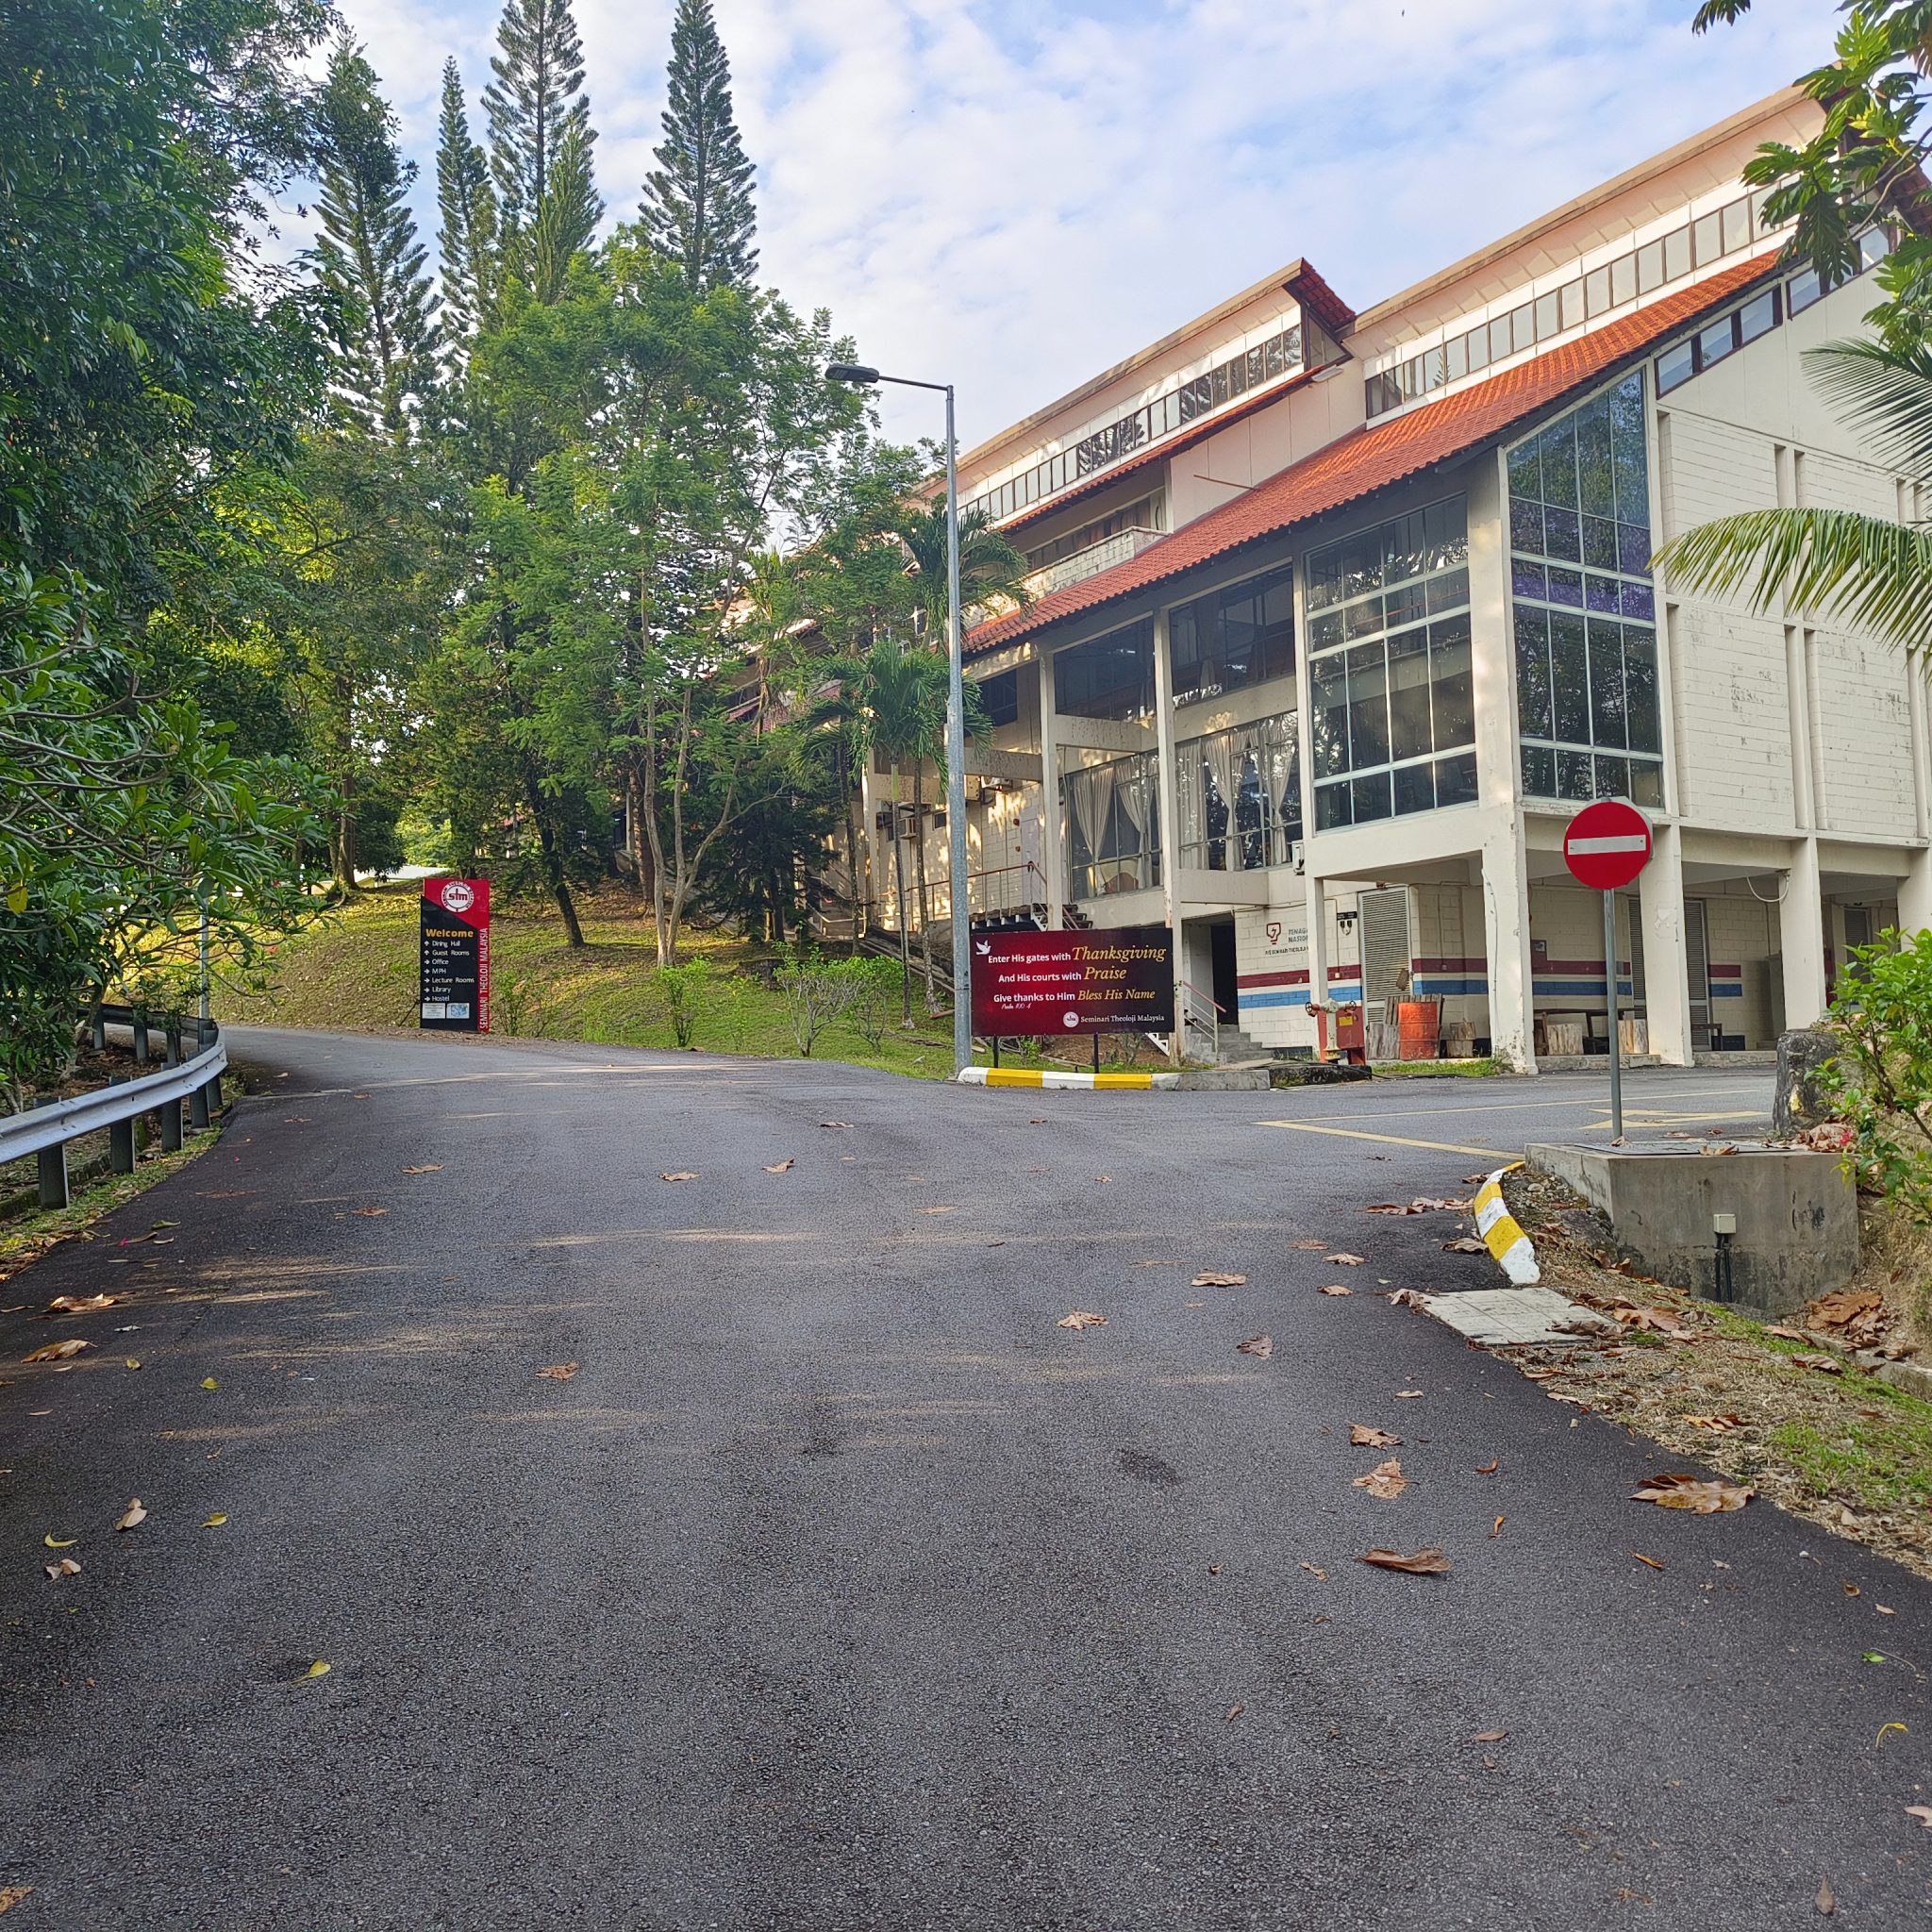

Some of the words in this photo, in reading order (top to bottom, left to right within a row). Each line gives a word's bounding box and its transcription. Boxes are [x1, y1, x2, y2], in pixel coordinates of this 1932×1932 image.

[448, 888, 468, 901] stm
[425, 928, 474, 938] Welcome
[479, 928, 489, 962] MALAYSIA
[1011, 954, 1024, 962] His
[1026, 954, 1049, 964] gates
[1051, 952, 1071, 960] with
[1072, 944, 1166, 962] Thanksgiving
[479, 963, 489, 994] THEOLOJI
[998, 974, 1015, 983] And
[1061, 972, 1081, 980] with
[1084, 965, 1127, 980] Praise
[993, 993, 1011, 1002] Give
[1013, 992, 1043, 1001] thanks
[1057, 991, 1075, 1000] Him
[1077, 990, 1103, 1000] Bless
[1104, 989, 1123, 1000] His
[1125, 989, 1156, 999] Name
[479, 996, 489, 1029] SEMINARI
[1138, 1014, 1164, 1023] Malaysia
